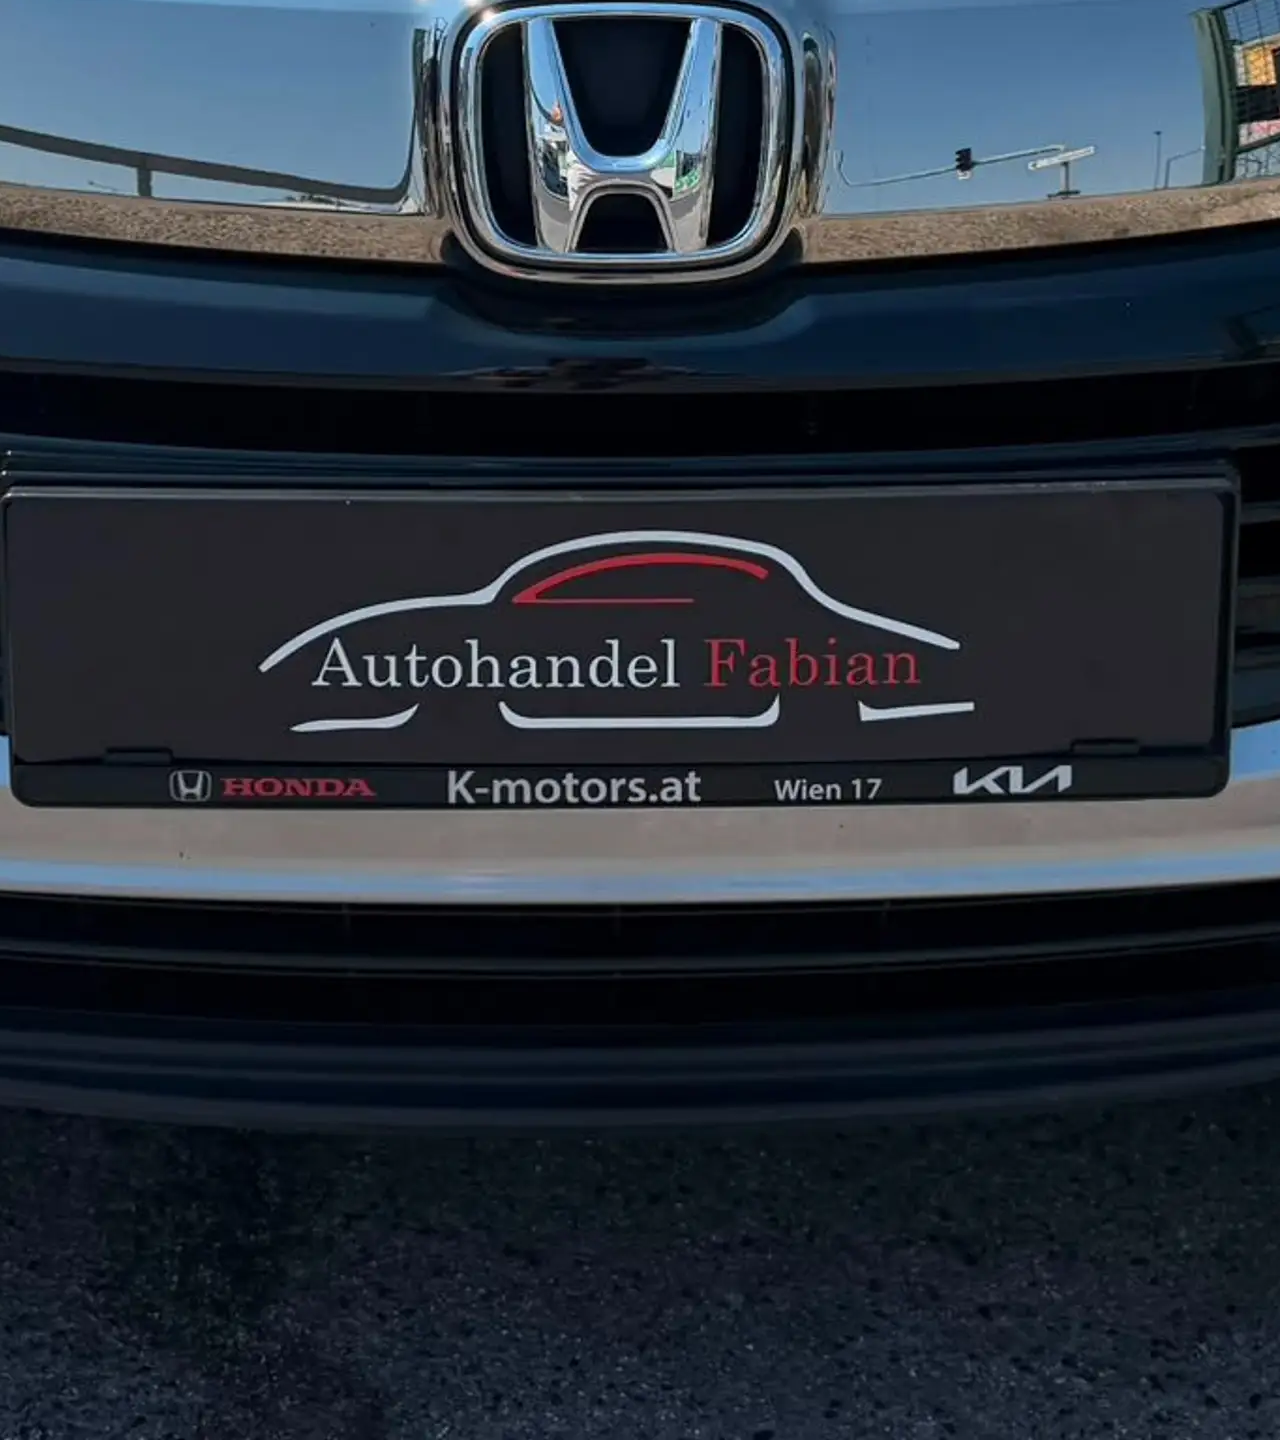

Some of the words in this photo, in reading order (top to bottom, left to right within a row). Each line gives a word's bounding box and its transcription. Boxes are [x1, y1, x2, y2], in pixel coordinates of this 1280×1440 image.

[310, 637, 679, 690] Autohandel
[703, 637, 922, 690] Fabian
[223, 777, 376, 798] HONDA
[448, 768, 702, 805] K-motors.at
[774, 777, 845, 802] Wien
[852, 777, 883, 802] 17
[952, 764, 1074, 796] KIA
